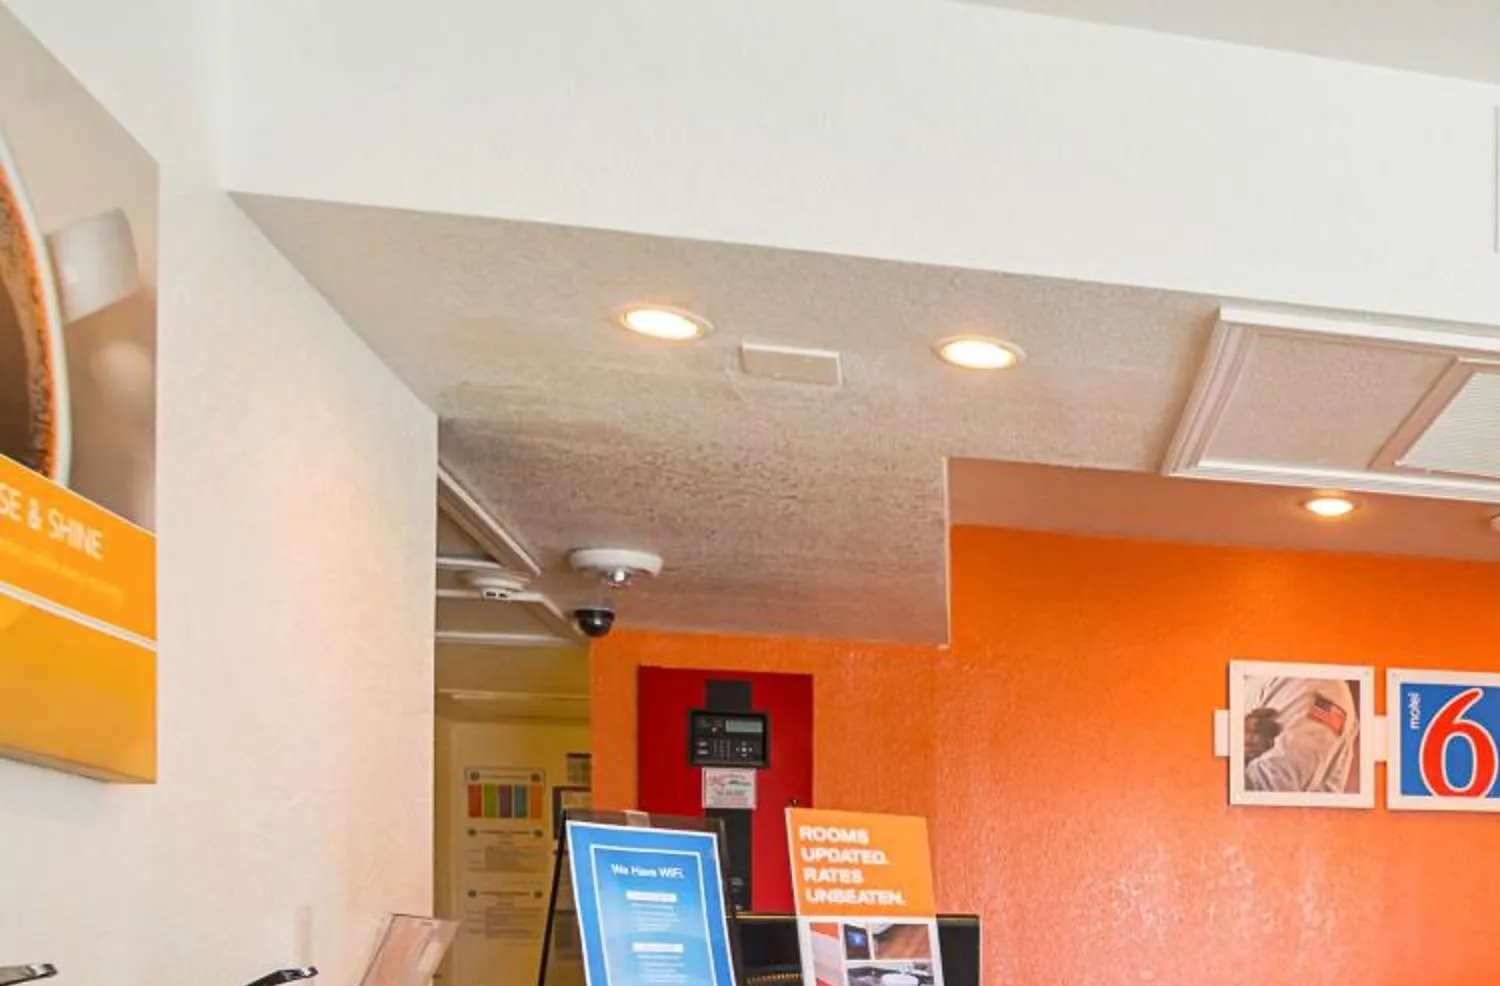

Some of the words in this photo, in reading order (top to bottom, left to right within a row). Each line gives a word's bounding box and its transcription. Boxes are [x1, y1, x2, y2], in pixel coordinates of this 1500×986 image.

[27, 498, 42, 531] &
[48, 508, 104, 560] SHINE
[1410, 692, 1421, 729] motel
[1419, 688, 1499, 797] 6
[800, 826, 868, 843] ROOMS
[801, 848, 888, 864] UPDATED.
[612, 864, 628, 876] We
[803, 868, 863, 883] RATES
[805, 889, 905, 905] UNBEATEN.
